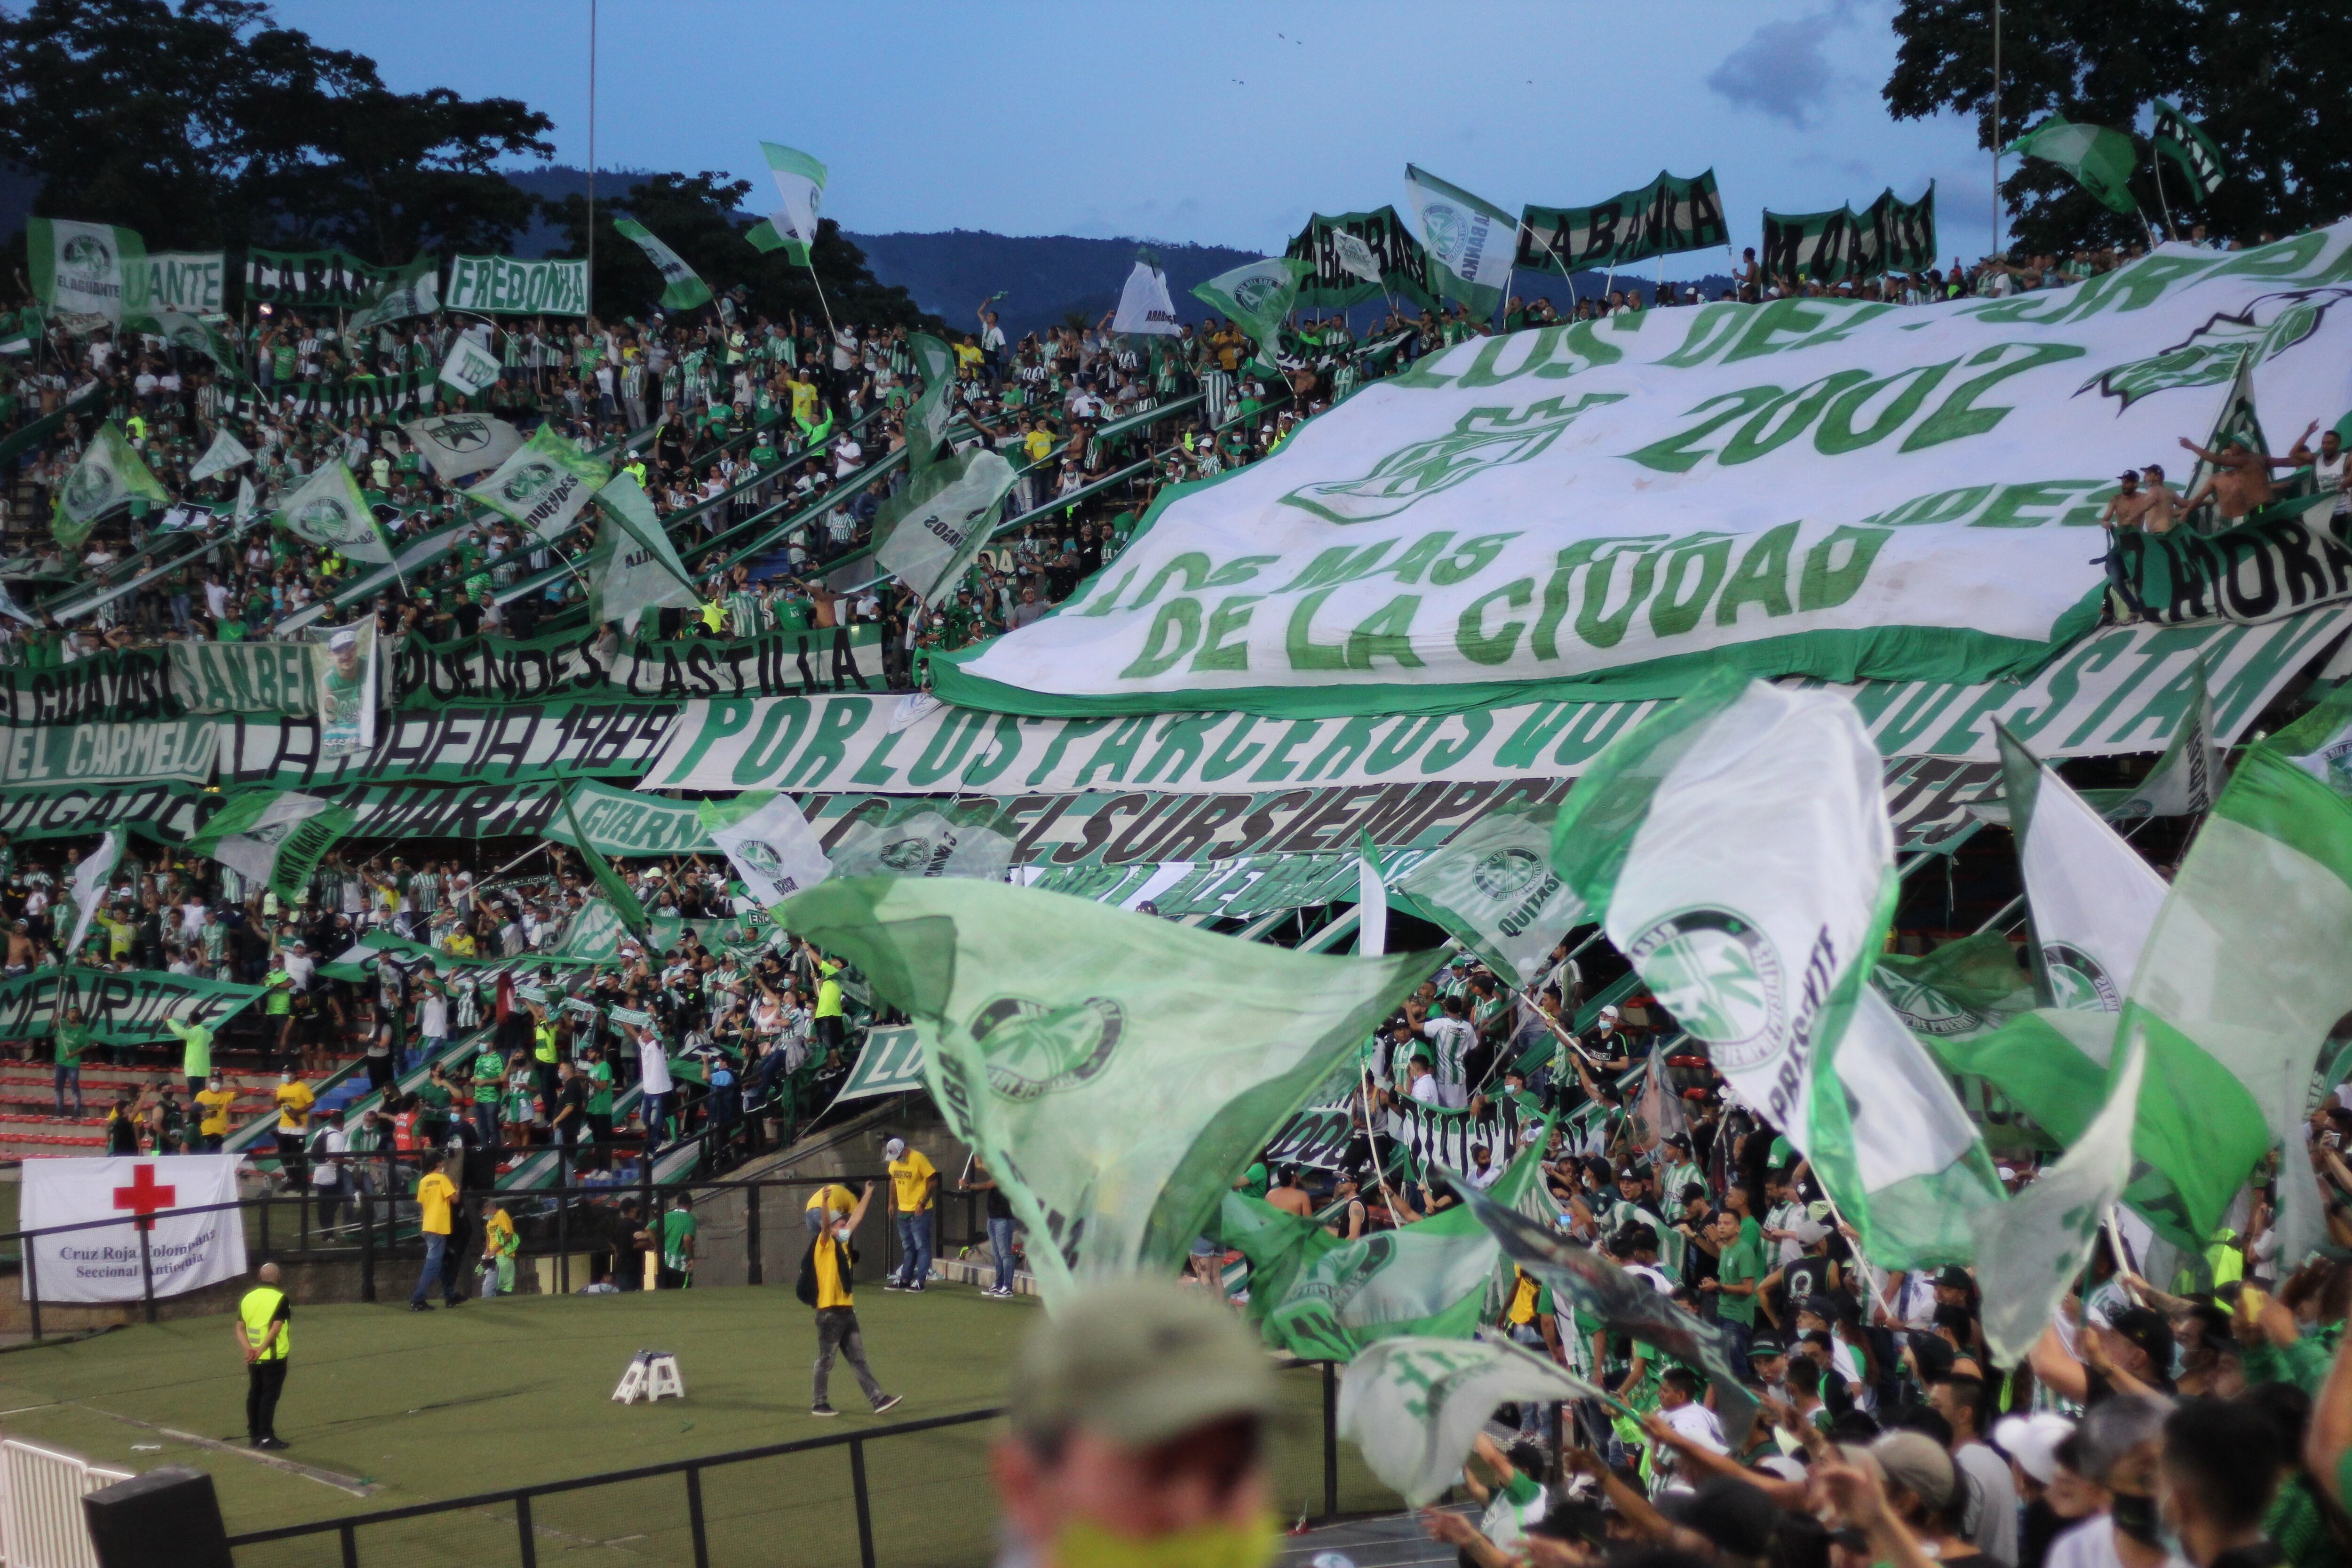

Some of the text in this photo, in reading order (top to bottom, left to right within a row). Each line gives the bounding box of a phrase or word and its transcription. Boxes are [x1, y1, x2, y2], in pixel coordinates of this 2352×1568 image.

[1517, 181, 1727, 267] LA BANKA
[71, 278, 120, 298] AGUANTE
[452, 259, 585, 313] FREDONIA
[1387, 308, 1649, 389] LOS
[1647, 297, 1897, 368] DEL
[1613, 342, 2087, 472] 2002
[524, 472, 579, 530] DUENDES
[1269, 532, 1524, 594] MAS
[1119, 595, 1267, 679] DE
[1285, 587, 1426, 670] LA
[1454, 520, 1894, 665] CIUDAD
[393, 627, 871, 702] DUENDES CASTILLA
[7, 720, 216, 781] EL CARMELO
[233, 714, 321, 786] LA
[540, 702, 679, 772] 1989
[660, 697, 874, 788] POR
[848, 704, 1023, 787] LOS
[1025, 709, 1494, 787] PARCEROS
[287, 819, 335, 859] MARIA
[1051, 793, 1253, 865] SUR
[1208, 777, 1573, 861] SIEMPR
[1, 974, 253, 1039] MANRIQUE
[60, 1246, 98, 1260] Cruz
[103, 1246, 136, 1263] Roja
[76, 1265, 137, 1279] Seccional
